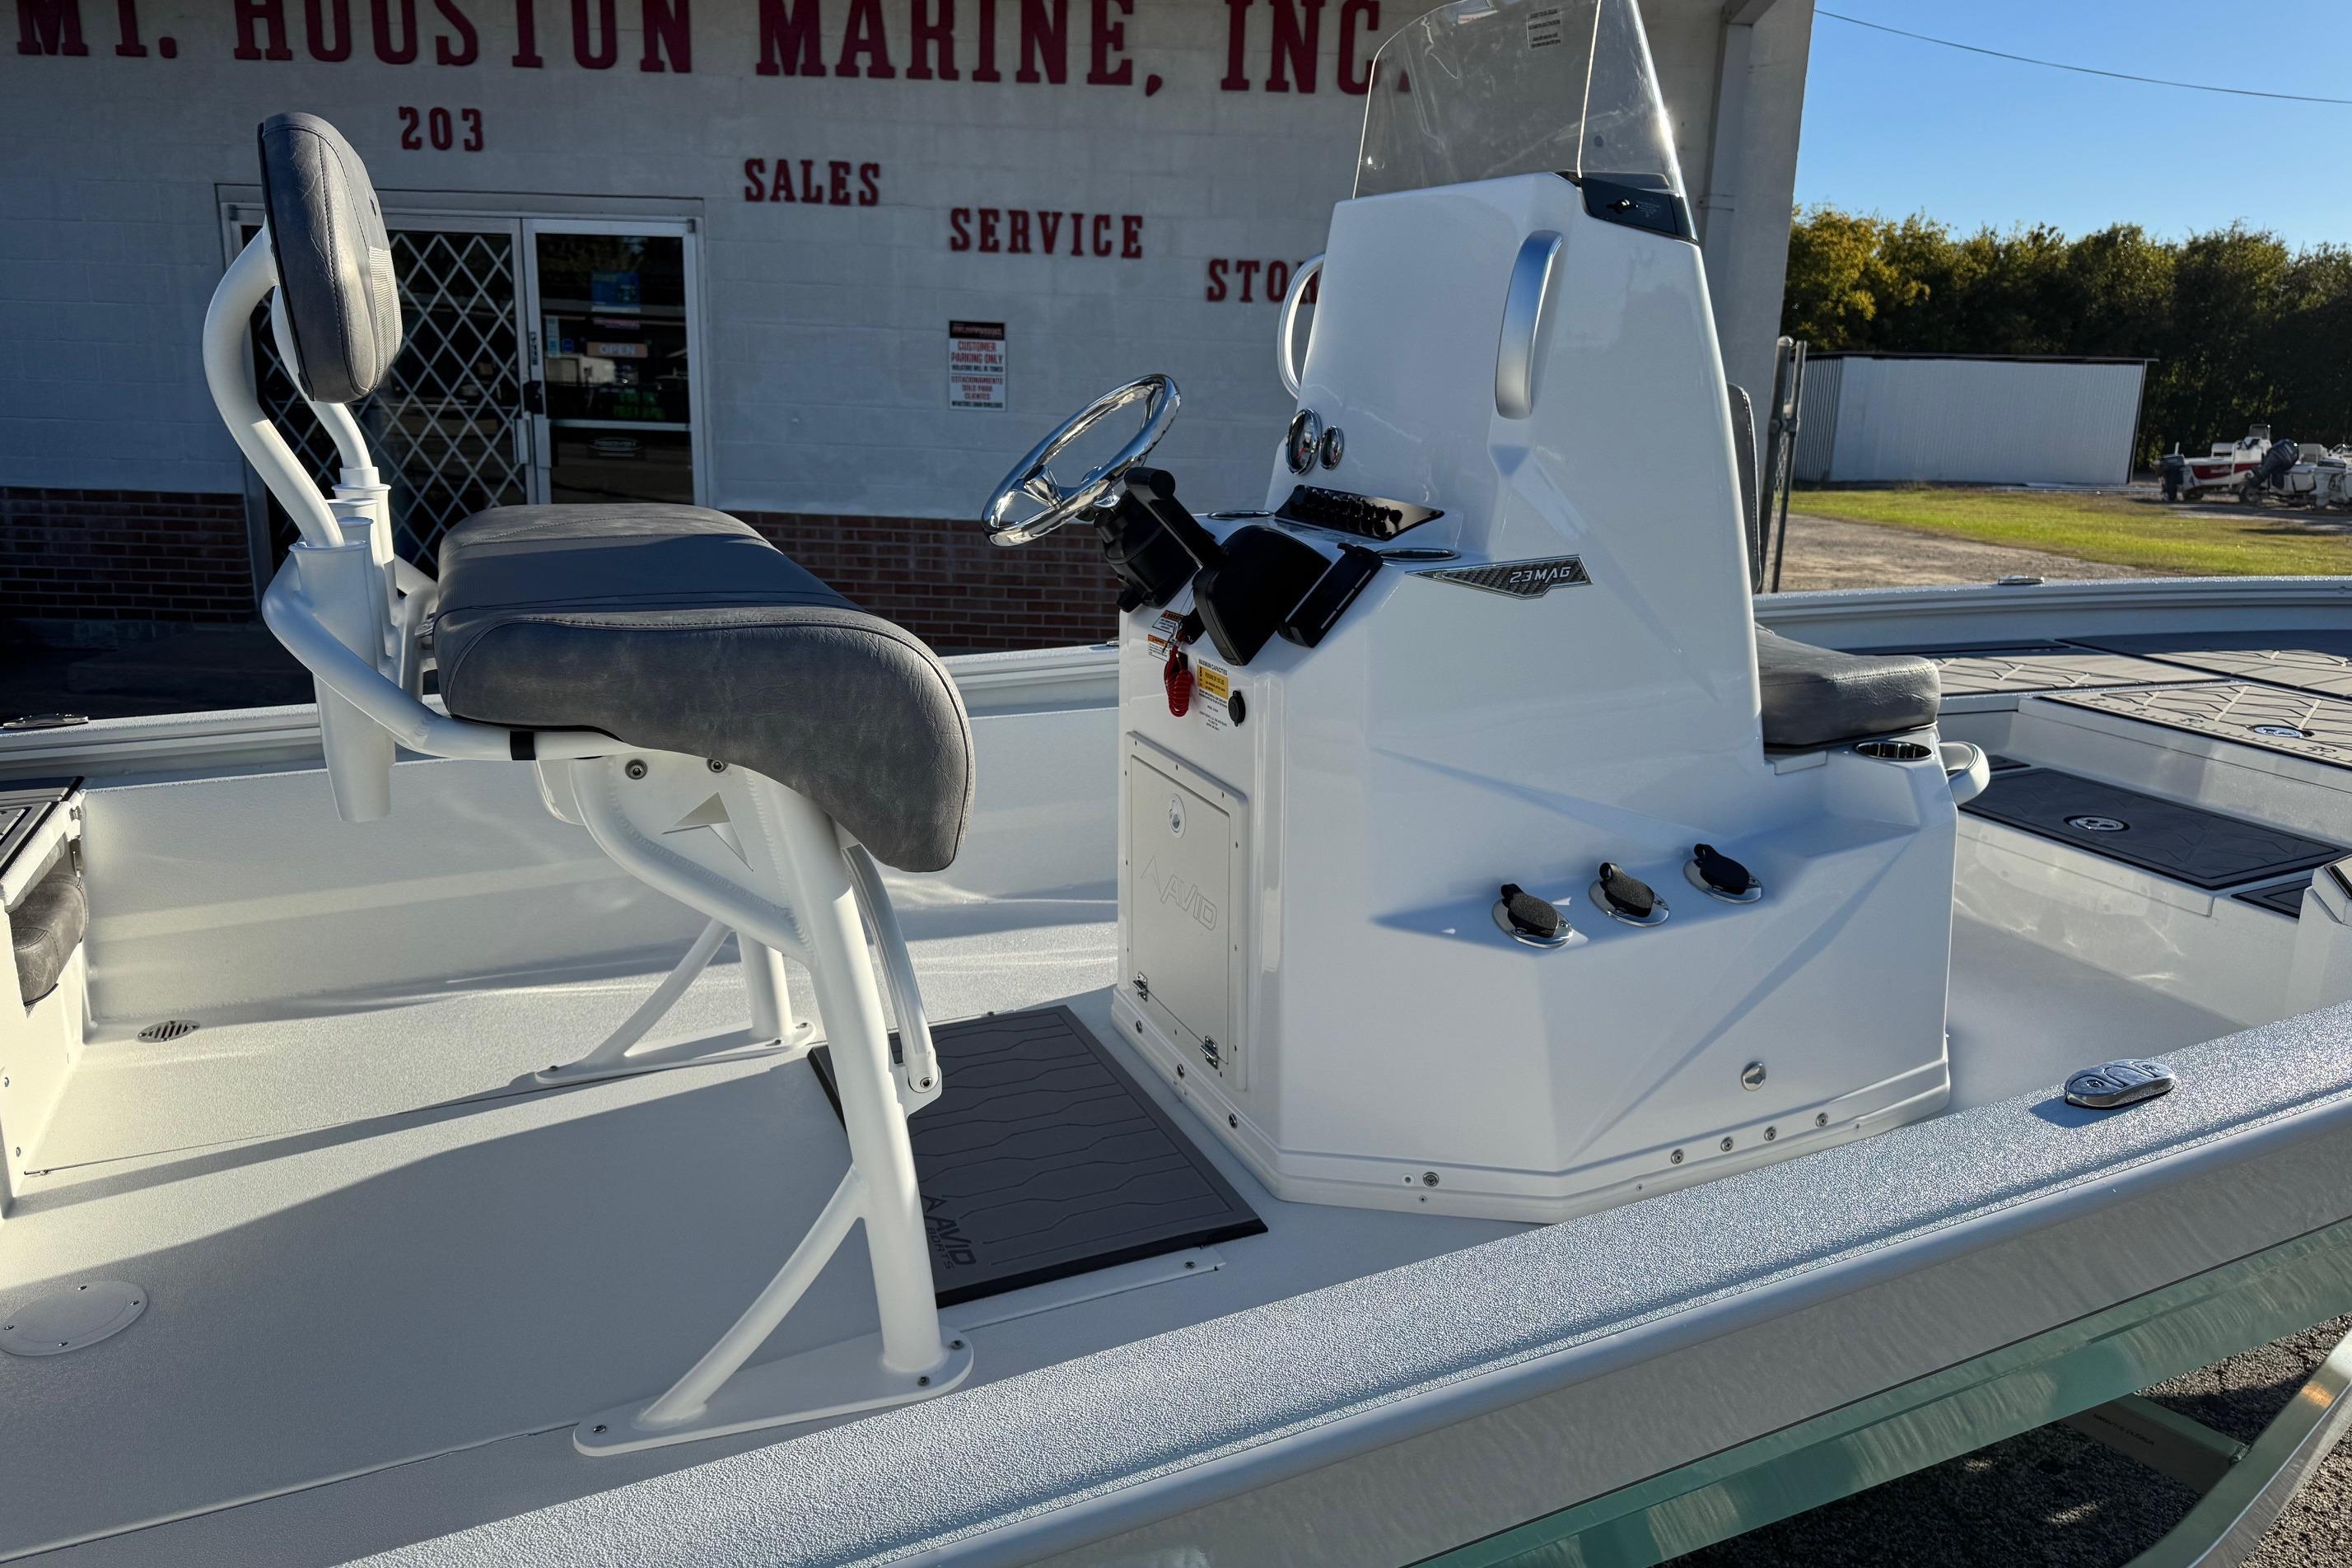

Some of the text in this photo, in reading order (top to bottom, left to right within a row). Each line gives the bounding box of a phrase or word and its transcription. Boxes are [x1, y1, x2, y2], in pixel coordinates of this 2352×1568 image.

[233, 0, 692, 73] HOUSTON
[399, 106, 484, 152] 203
[744, 158, 880, 207] SALES
[950, 208, 1144, 259] SERVICE
[599, 344, 637, 356] OPEN
[951, 352, 1003, 364] PARKING ONLY
[958, 340, 996, 352] CUSTOMER
[1160, 874, 1218, 931] AVID
